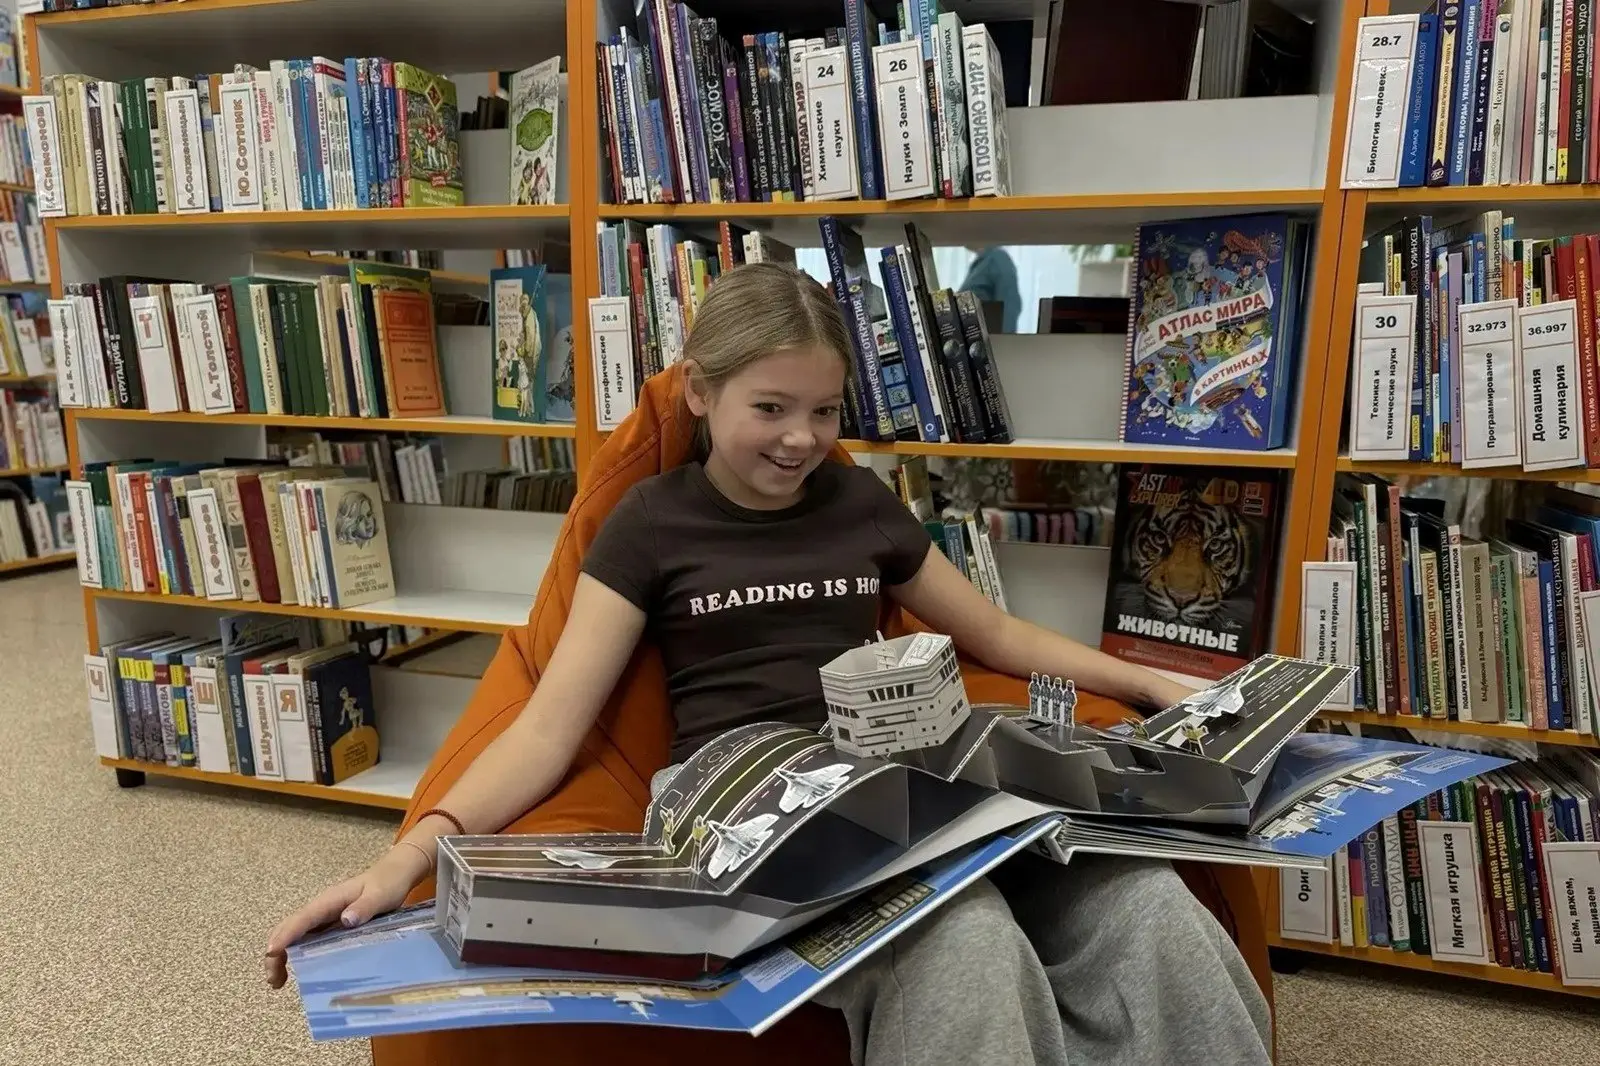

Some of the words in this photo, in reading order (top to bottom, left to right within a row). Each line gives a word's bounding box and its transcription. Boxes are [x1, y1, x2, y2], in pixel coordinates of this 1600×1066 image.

[1464, 6, 1475, 56] ДОСТИЖЕНИЯ
[1579, 4, 1587, 30] ЧУДО
[945, 28, 955, 79] МИНЕРАЛАХ
[1372, 36, 1402, 47] 28.7
[1563, 28, 1572, 74] ЧЕЛОВЕКЕ
[1577, 34, 1586, 76] ГЛАВНОЕ
[746, 51, 759, 106] Вселенной
[817, 65, 835, 78] 24
[889, 59, 908, 72] 26
[968, 62, 985, 96] МИР
[1461, 58, 1472, 100] УВЛЕЧЕНИЯ,
[706, 80, 726, 142] КОСМОС
[794, 81, 806, 112] МИР
[898, 85, 908, 128] Земле
[1413, 64, 1426, 123] ЧЕЛОВЕЧЕСКИЙ
[1493, 70, 1504, 110] Человек
[752, 108, 766, 163] катастроф
[972, 100, 991, 166] ПОЗНАЮ
[1366, 122, 1381, 173] Биология
[1374, 66, 1388, 118] человека
[1458, 102, 1469, 138] РЕКОРДЫ,
[233, 98, 250, 196] Ю.Сотник
[798, 114, 812, 173] ПОЗНАЮ
[815, 100, 827, 182] Химические
[1455, 139, 1464, 172] ЧЕЛОВЕК:
[95, 148, 106, 199] СИМОНОВ
[268, 150, 276, 176] СОТНИК
[760, 165, 769, 188] 1000
[803, 176, 814, 188] Я
[903, 143, 913, 183] Науки
[976, 170, 992, 183] Я
[1410, 227, 1418, 268] ТЕХНИКА
[834, 278, 846, 303] Атлас
[139, 313, 153, 338] Т
[853, 298, 871, 347] ОТКРЫТИЯ
[1158, 310, 1213, 340] АТЛАС
[1216, 294, 1266, 318] МИРА
[1375, 315, 1397, 329] 30
[1468, 321, 1506, 332] 32.973
[1528, 323, 1567, 336] 36.997
[111, 341, 128, 403] СТРУГАЦКИЕ
[196, 309, 222, 400] А.Толстой
[1200, 349, 1268, 388] КАРТИНКАХ
[1389, 347, 1397, 376] науки
[598, 336, 612, 421] Географические
[1370, 378, 1380, 420] Техника
[1386, 378, 1396, 440] технические
[1487, 353, 1496, 449] Программирование
[1532, 369, 1542, 442] Домашняя
[1556, 365, 1568, 439] кулинария
[1382, 575, 1387, 586] ИЗ
[1426, 562, 1434, 600] ПОДЕЛКИ
[1452, 547, 1462, 589] МАТЕРИАЛОВ
[1551, 538, 1563, 595] керамика
[690, 582, 815, 616] READING
[823, 578, 848, 597] IS
[855, 577, 880, 594] HO
[1319, 609, 1326, 621] из
[1330, 581, 1339, 638] материалов
[1442, 595, 1454, 639] Плетение
[1455, 590, 1464, 629] ПРИРОДНЫХ
[1556, 598, 1562, 606] и
[1117, 614, 1239, 652] ЖИВОТНЫЕ
[1428, 611, 1438, 659] ПРИРОДНЫХ
[1458, 630, 1464, 638] ИЗ
[1458, 640, 1468, 673] СУВЕНИРЫ
[196, 682, 215, 705] Ш
[280, 689, 297, 712] Я
[1431, 660, 1442, 711] МАТЕРИАЛОВ
[1460, 679, 1469, 709] ПОДАРКИ
[257, 685, 274, 772] В.Шукшин
[1402, 809, 1421, 877] ОРИГАМИ
[1483, 808, 1497, 855] ИГРУШКА
[1495, 821, 1509, 869] ИГРУШКА
[1366, 831, 1379, 886] Оригами
[1385, 823, 1405, 907] ОРИГАМИ
[1443, 833, 1459, 894] игрушка
[1490, 859, 1502, 898] МЯГКАЯ
[1298, 869, 1312, 902] Ориг
[1503, 872, 1515, 911] МЯГКАЯ
[1564, 877, 1578, 916] вяжем,
[1451, 898, 1464, 948] Мягкая
[1569, 919, 1583, 953] Шьём,
[1586, 886, 1600, 945] вышиваем
